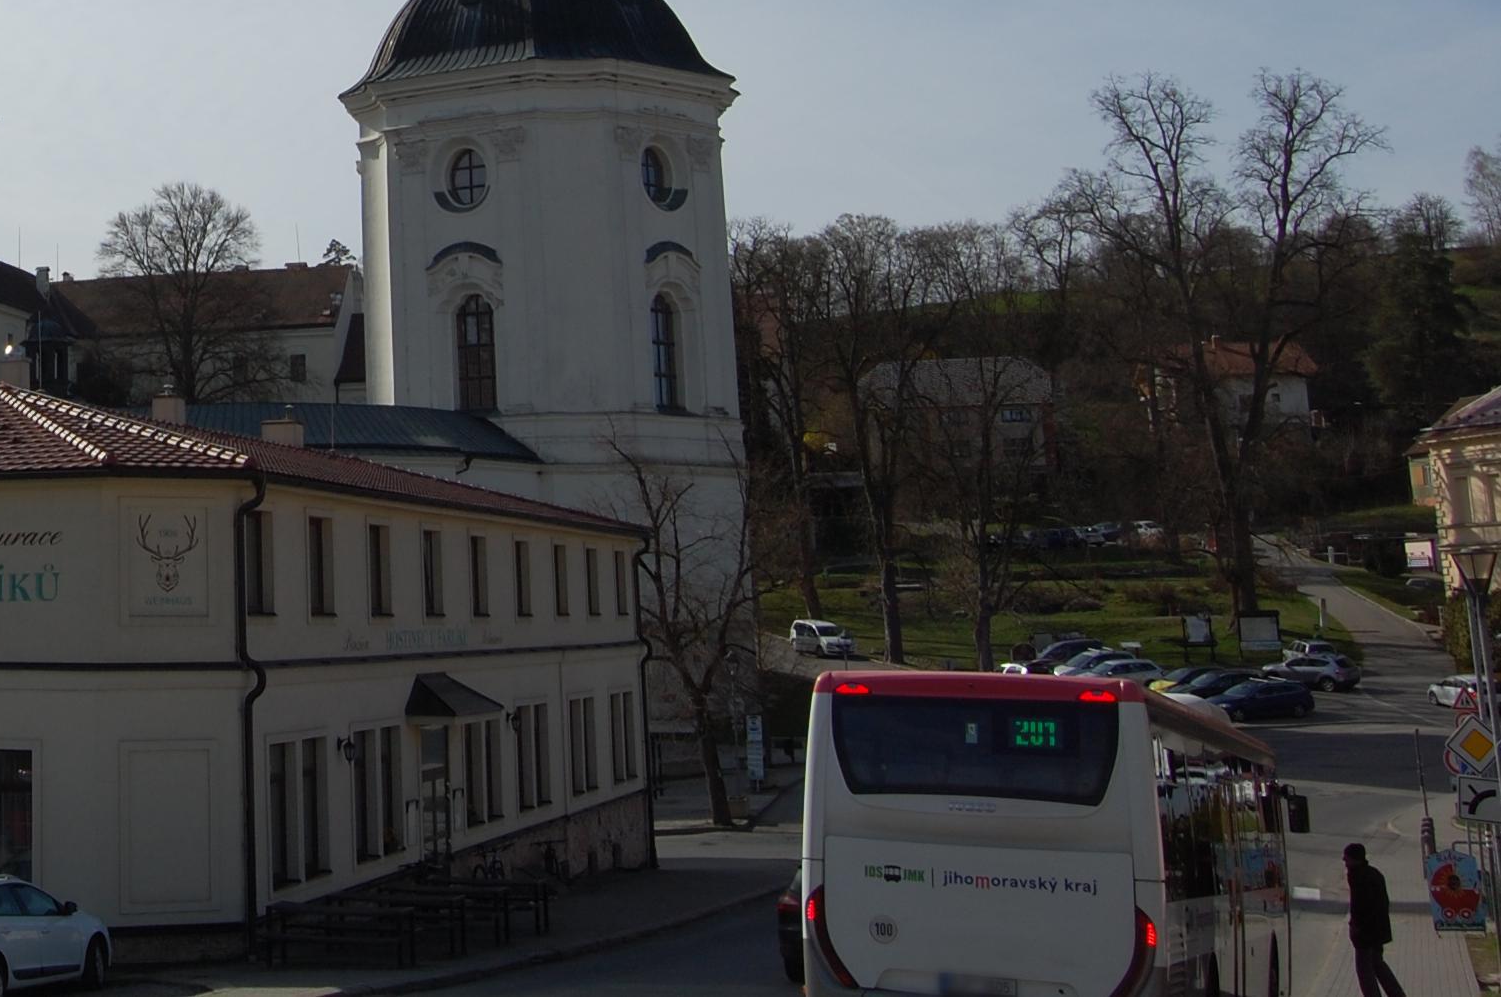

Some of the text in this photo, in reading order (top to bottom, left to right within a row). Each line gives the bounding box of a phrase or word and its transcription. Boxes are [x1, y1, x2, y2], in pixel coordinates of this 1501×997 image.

[864, 865, 925, 883] IDS JMK
[943, 871, 1098, 895] jihomoravský kraj
[875, 922, 893, 936] 100
